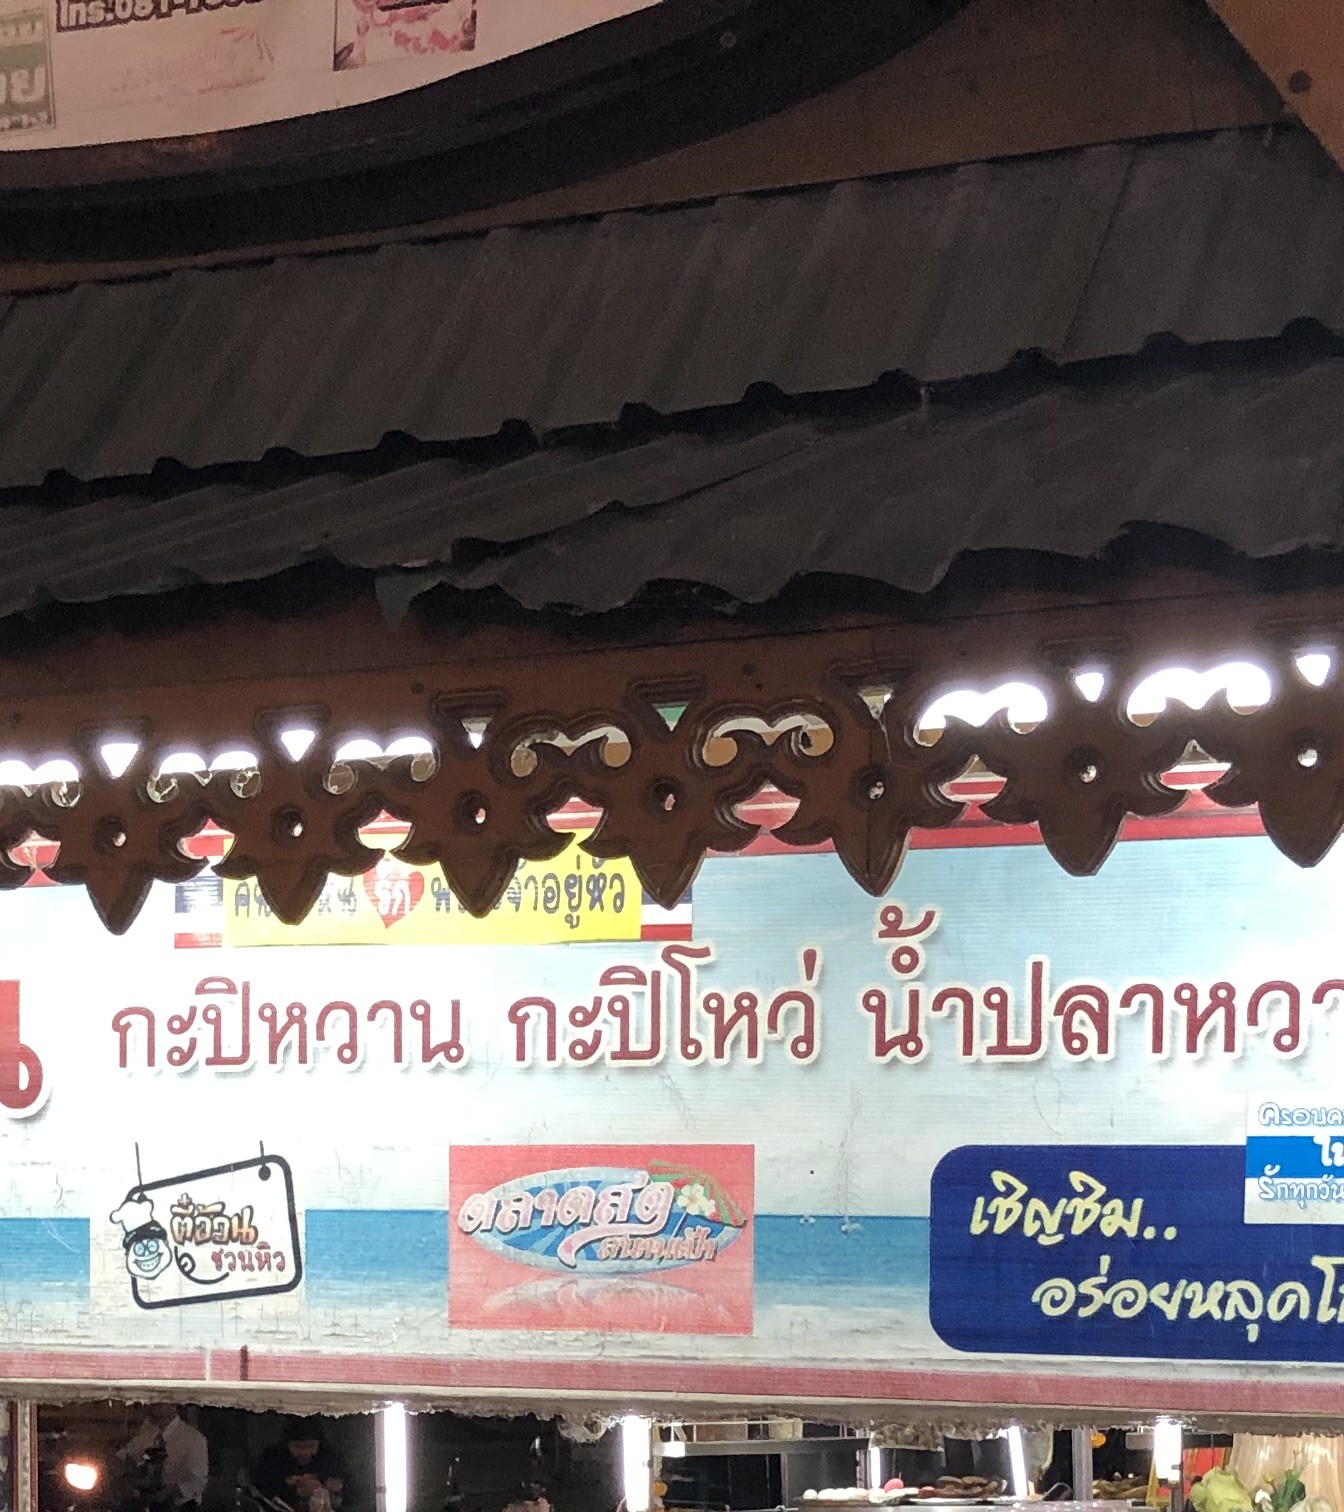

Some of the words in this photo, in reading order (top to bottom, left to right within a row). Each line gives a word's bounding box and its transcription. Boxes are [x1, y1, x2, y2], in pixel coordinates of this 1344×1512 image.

[110, 976, 465, 1070] กะปิหวาน
[506, 945, 820, 1067] กะปิโหว่
[211, 1241, 287, 1273] ชวนหิว
